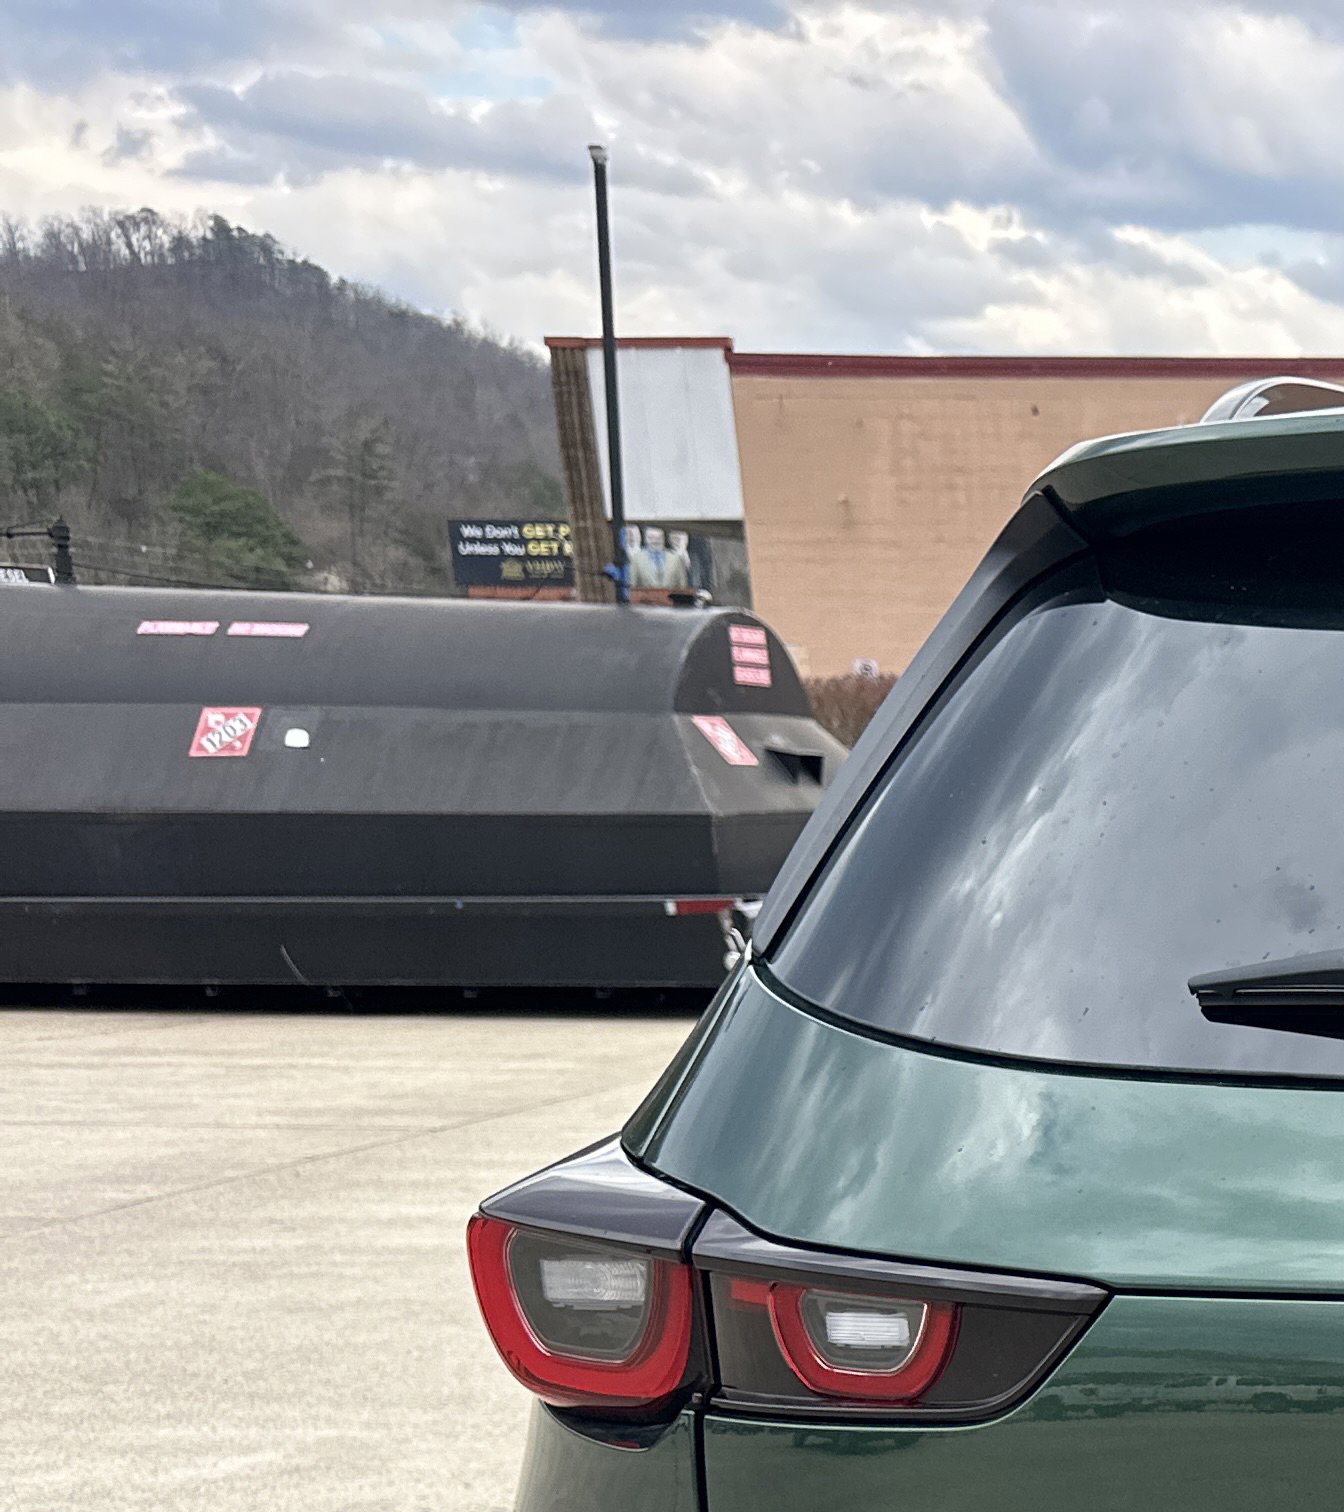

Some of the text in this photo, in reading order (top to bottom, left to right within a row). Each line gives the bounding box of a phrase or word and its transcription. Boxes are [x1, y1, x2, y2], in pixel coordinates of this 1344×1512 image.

[460, 523, 483, 538] We
[485, 523, 519, 538] Don't
[522, 523, 555, 539] GET
[458, 541, 500, 556] Unless
[501, 541, 526, 556] You
[527, 540, 559, 556] GET
[206, 716, 248, 750] 1203
